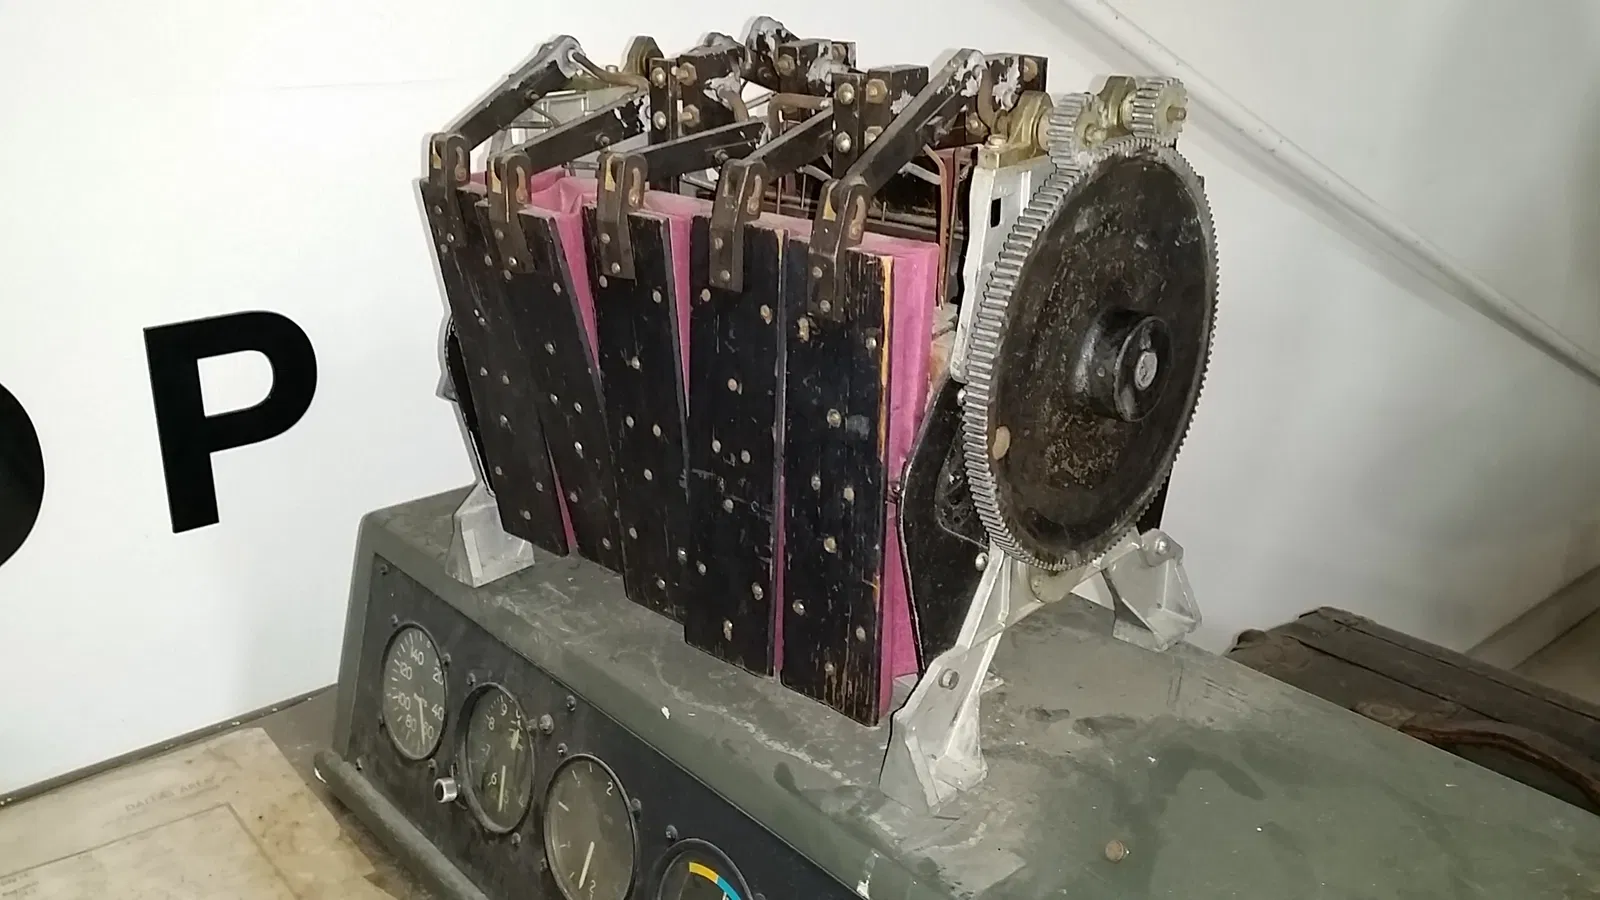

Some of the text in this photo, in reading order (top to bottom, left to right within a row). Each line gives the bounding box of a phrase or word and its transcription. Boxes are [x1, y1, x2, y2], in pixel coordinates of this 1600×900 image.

[431, 703, 445, 721] 40
[500, 702, 508, 717] 9
[405, 714, 417, 732] 80
[488, 716, 496, 731] 8
[491, 772, 498, 786] 6
[606, 781, 614, 796] 2
[589, 879, 597, 894] 2
